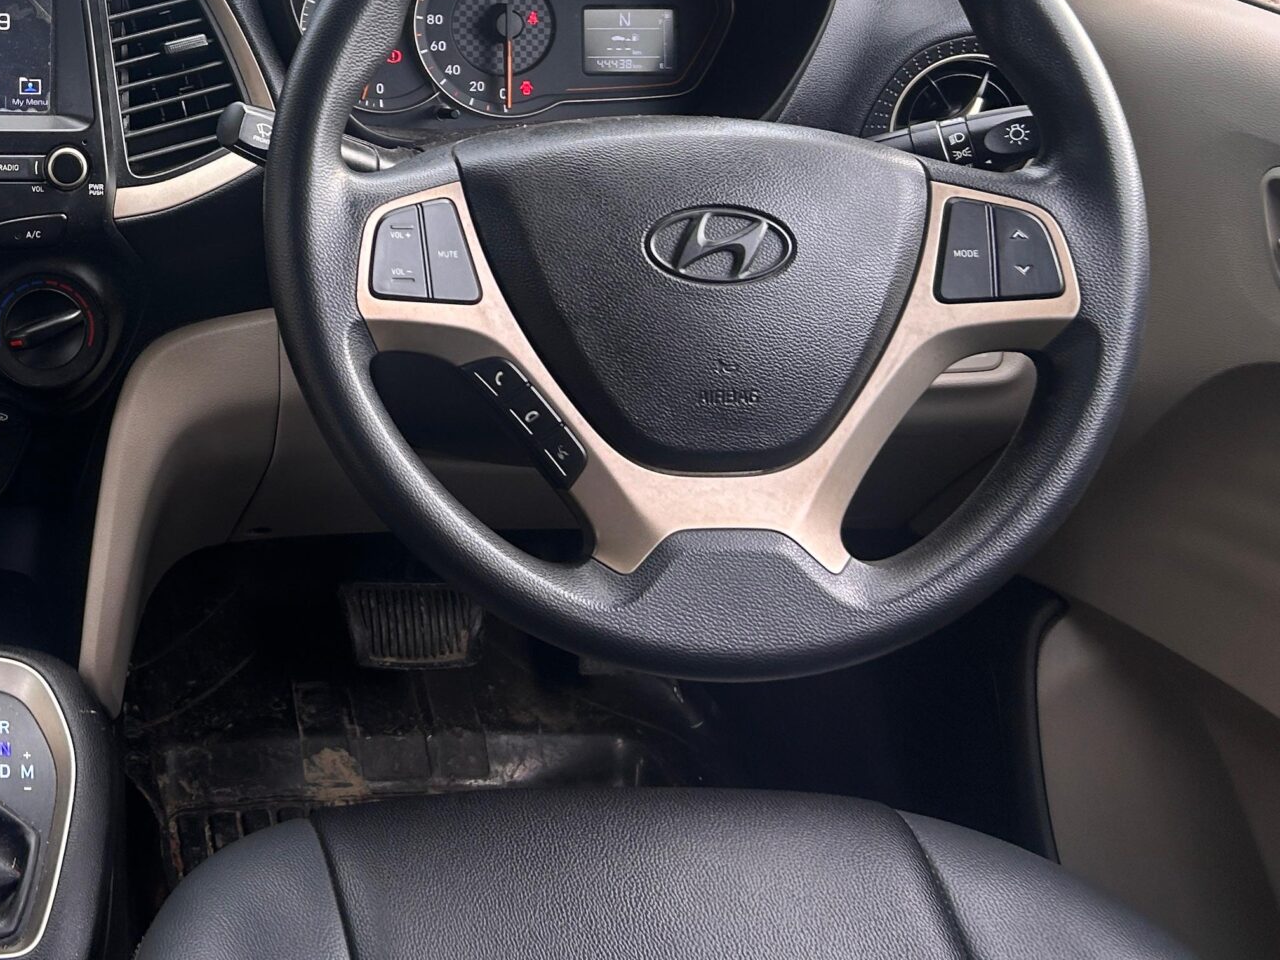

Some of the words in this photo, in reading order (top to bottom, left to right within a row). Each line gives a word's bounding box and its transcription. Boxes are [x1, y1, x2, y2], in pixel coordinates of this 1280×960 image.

[427, 15, 443, 24] 80
[620, 12, 631, 26] N
[430, 41, 446, 51] 60
[445, 65, 460, 75] 40
[376, 83, 384, 94] 0
[470, 82, 485, 91] 20
[12, 98, 24, 107] My
[438, 250, 458, 258] MUTE
[696, 390, 758, 406] AIRBAG
[0, 721, 9, 734] R
[0, 742, 10, 756] N
[0, 764, 10, 778] D
[21, 764, 34, 779] M
